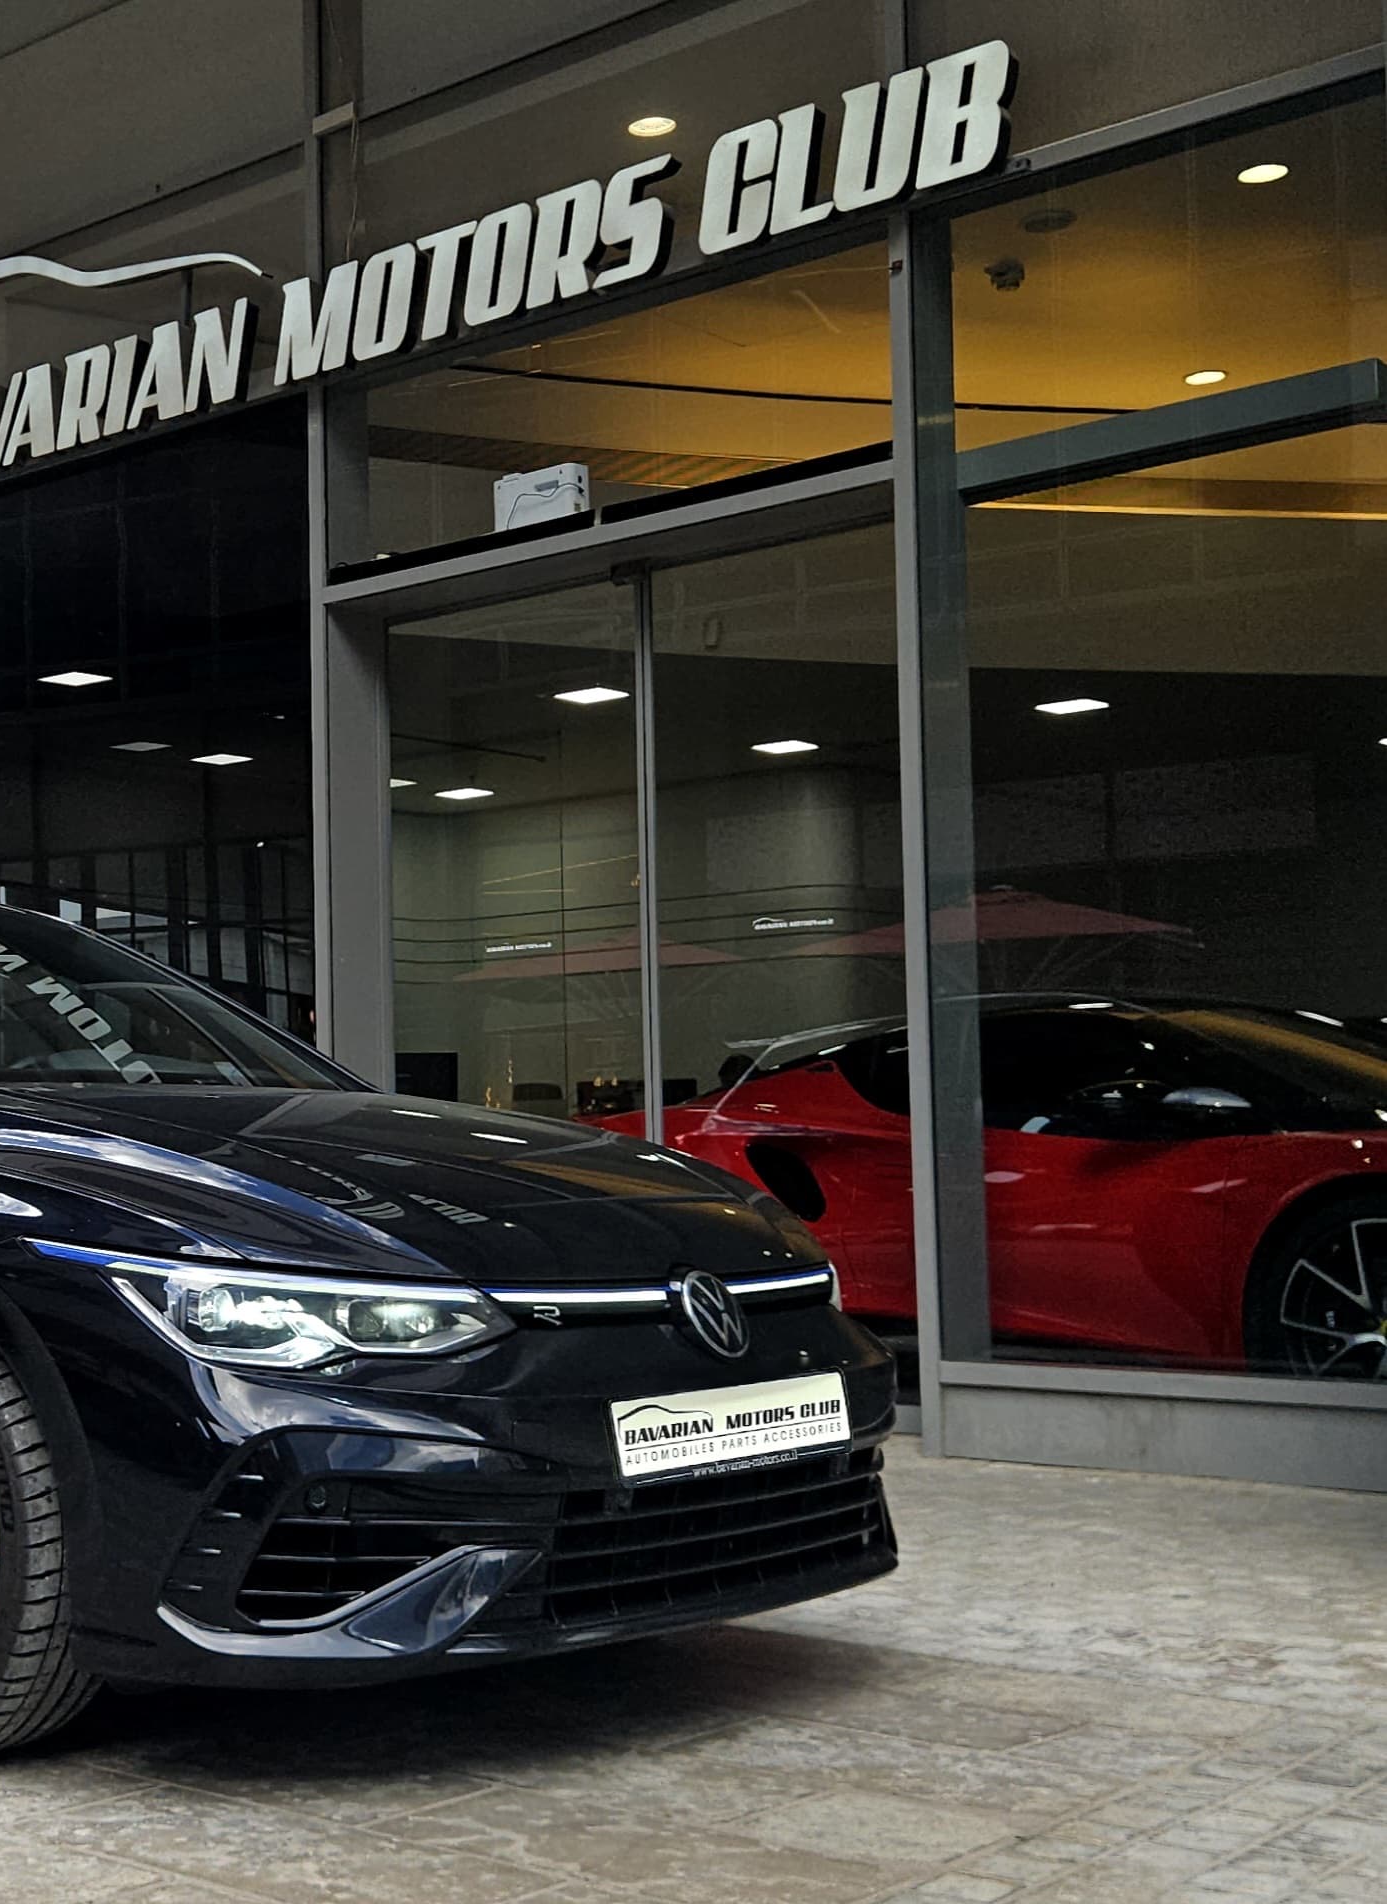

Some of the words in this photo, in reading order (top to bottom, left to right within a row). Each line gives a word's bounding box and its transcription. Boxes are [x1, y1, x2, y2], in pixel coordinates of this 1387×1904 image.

[274, 154, 676, 387] MOTORS
[699, 40, 1015, 255] CLUB
[625, 1419, 713, 1445] BAVARIAN
[726, 1406, 795, 1430] MOTORS
[800, 1399, 841, 1418] CLUB
[626, 1442, 715, 1466] AUTOMOBILES
[722, 1435, 758, 1450] PARTS
[764, 1422, 842, 1443] ACCESSORIES
